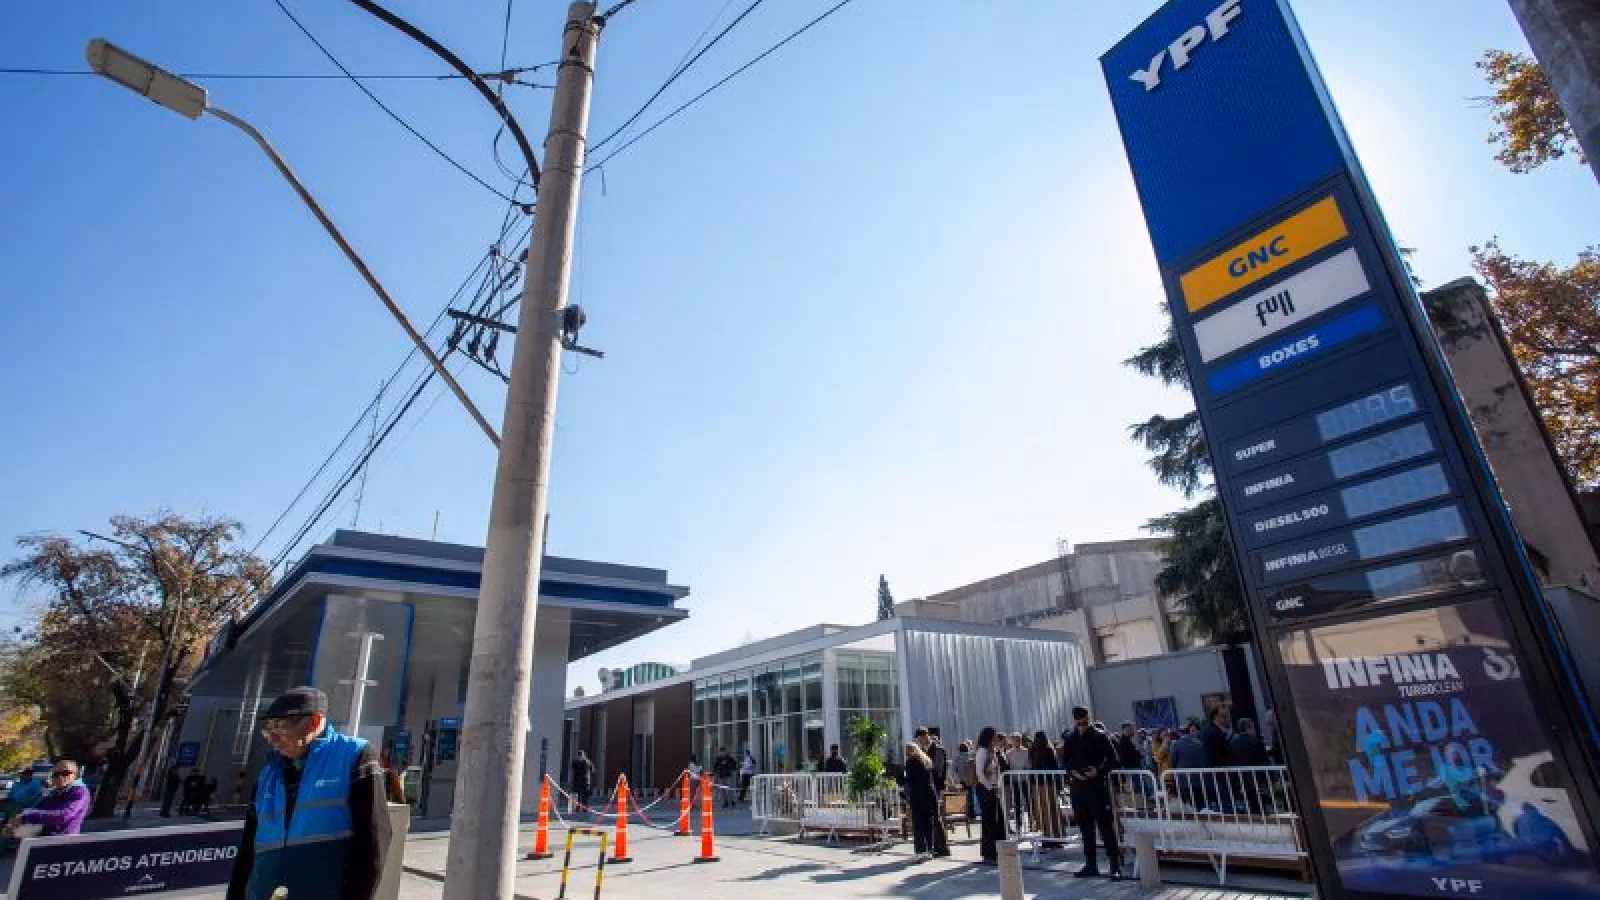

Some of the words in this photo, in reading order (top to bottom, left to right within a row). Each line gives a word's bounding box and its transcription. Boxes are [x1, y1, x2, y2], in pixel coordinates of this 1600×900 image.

[1127, 0, 1242, 92] YPF
[1228, 235, 1288, 278] GNC
[1255, 289, 1296, 327] full
[1259, 333, 1319, 368] BOXES
[1235, 439, 1277, 461] SUPER
[1244, 473, 1295, 496] INFINIA
[1254, 512, 1302, 532] DIESEL
[1265, 549, 1319, 571] INFINIA
[1275, 595, 1304, 611] GNC
[1321, 653, 1459, 689] INFINIA
[1355, 697, 1479, 752] ANDA
[1347, 738, 1500, 804] MEJOR
[32, 855, 132, 879] ESTAMOS
[1431, 877, 1483, 893] YPF
